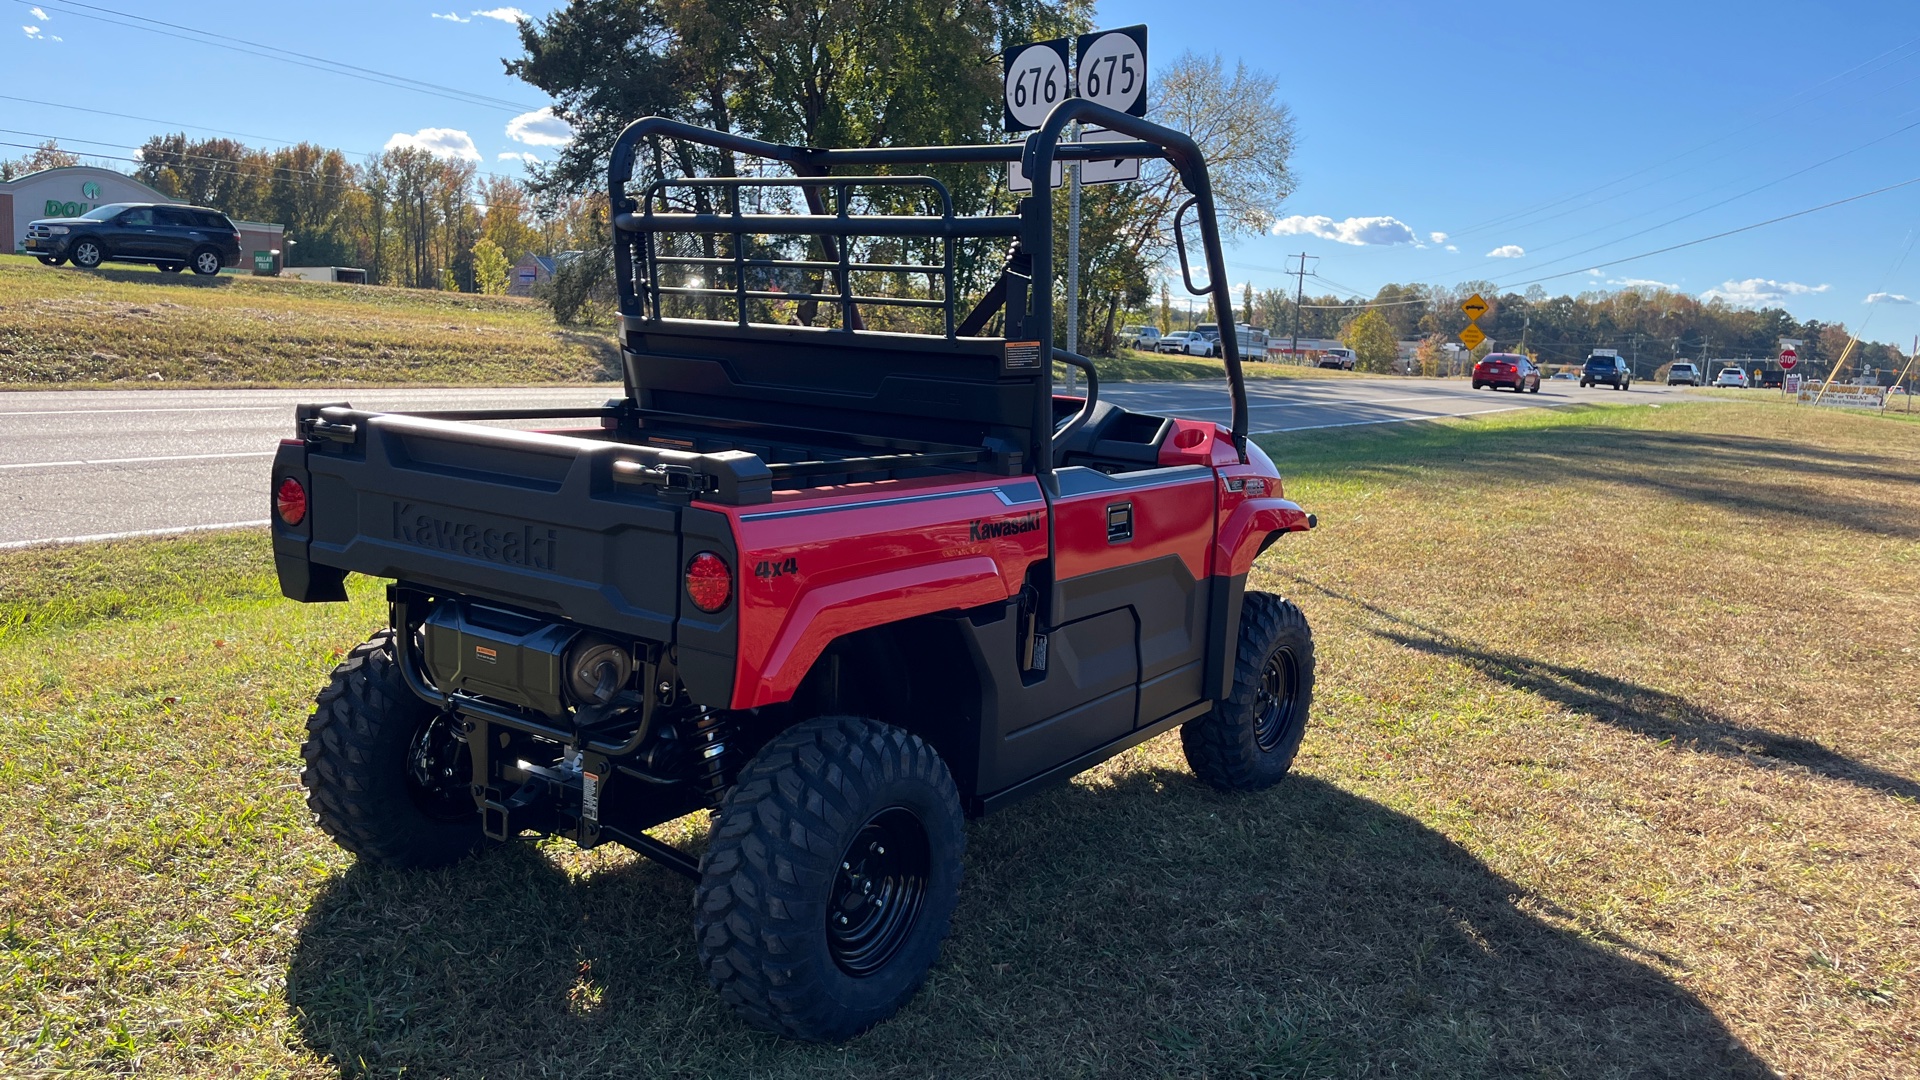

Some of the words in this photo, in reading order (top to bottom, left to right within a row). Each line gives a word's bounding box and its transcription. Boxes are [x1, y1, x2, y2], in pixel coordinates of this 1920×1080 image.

[1014, 64, 1057, 107] 676
[1087, 53, 1135, 97] 675
[1780, 355, 1796, 364] STOP
[393, 501, 557, 571] Kawasaki
[969, 511, 1040, 543] Kawasaki
[755, 557, 798, 579] 4x4
